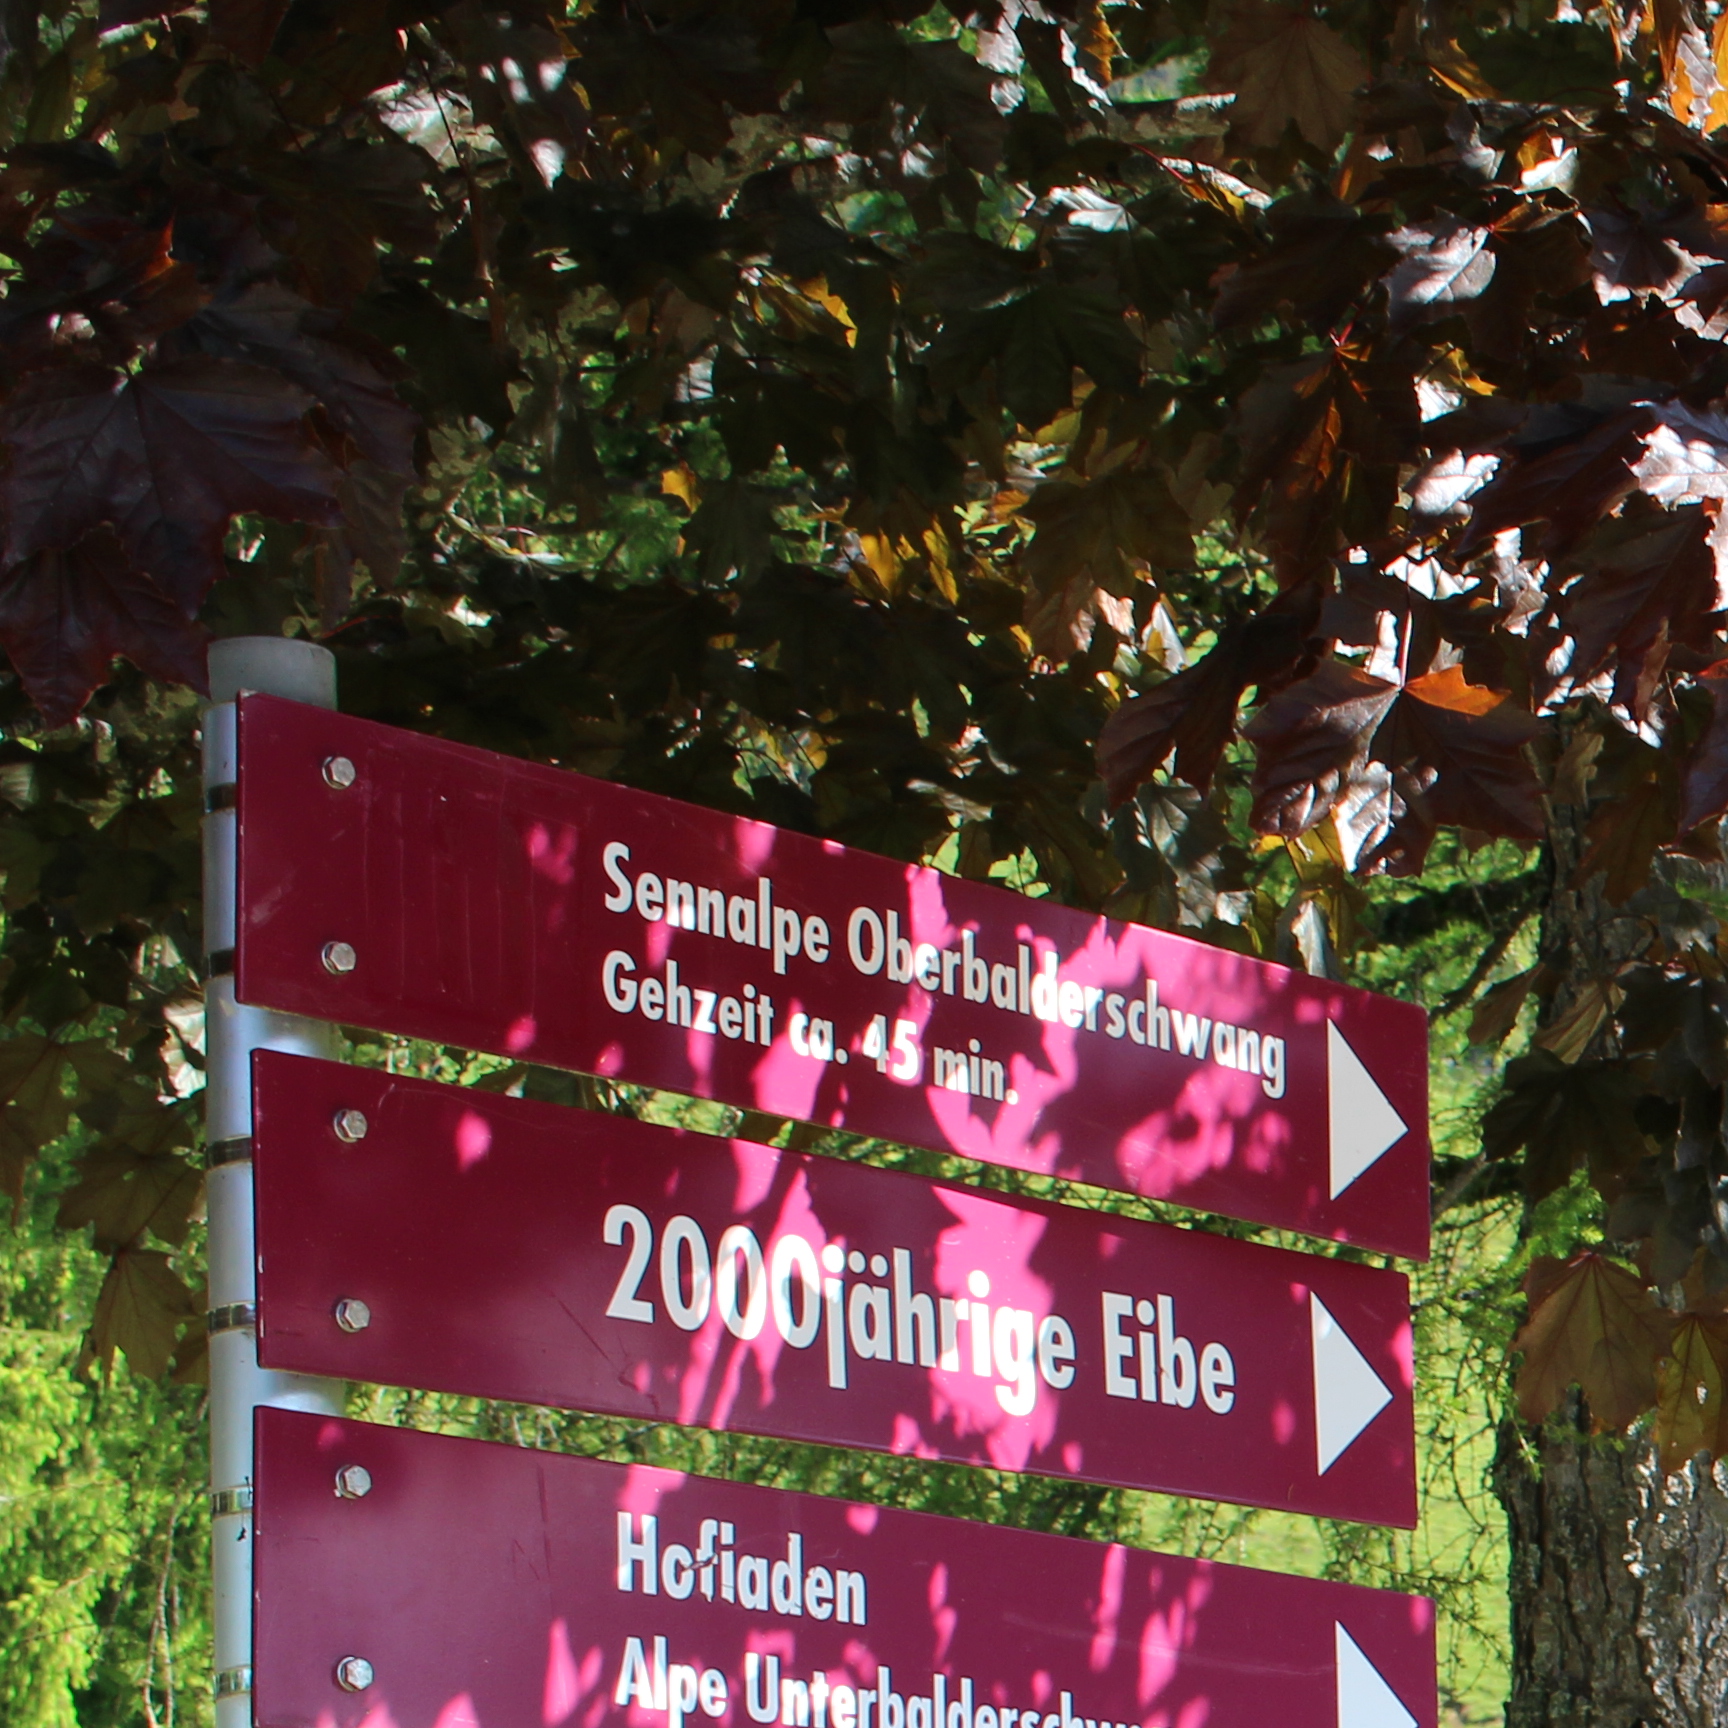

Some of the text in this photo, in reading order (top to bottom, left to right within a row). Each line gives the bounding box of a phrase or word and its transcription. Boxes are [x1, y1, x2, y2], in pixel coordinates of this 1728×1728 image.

[602, 840, 1286, 1100] Sennalpe Oberbalderschwang
[602, 949, 1019, 1106] Gehzeit ca. 45 min.
[602, 1203, 1237, 1417] 2000jährige Eibe
